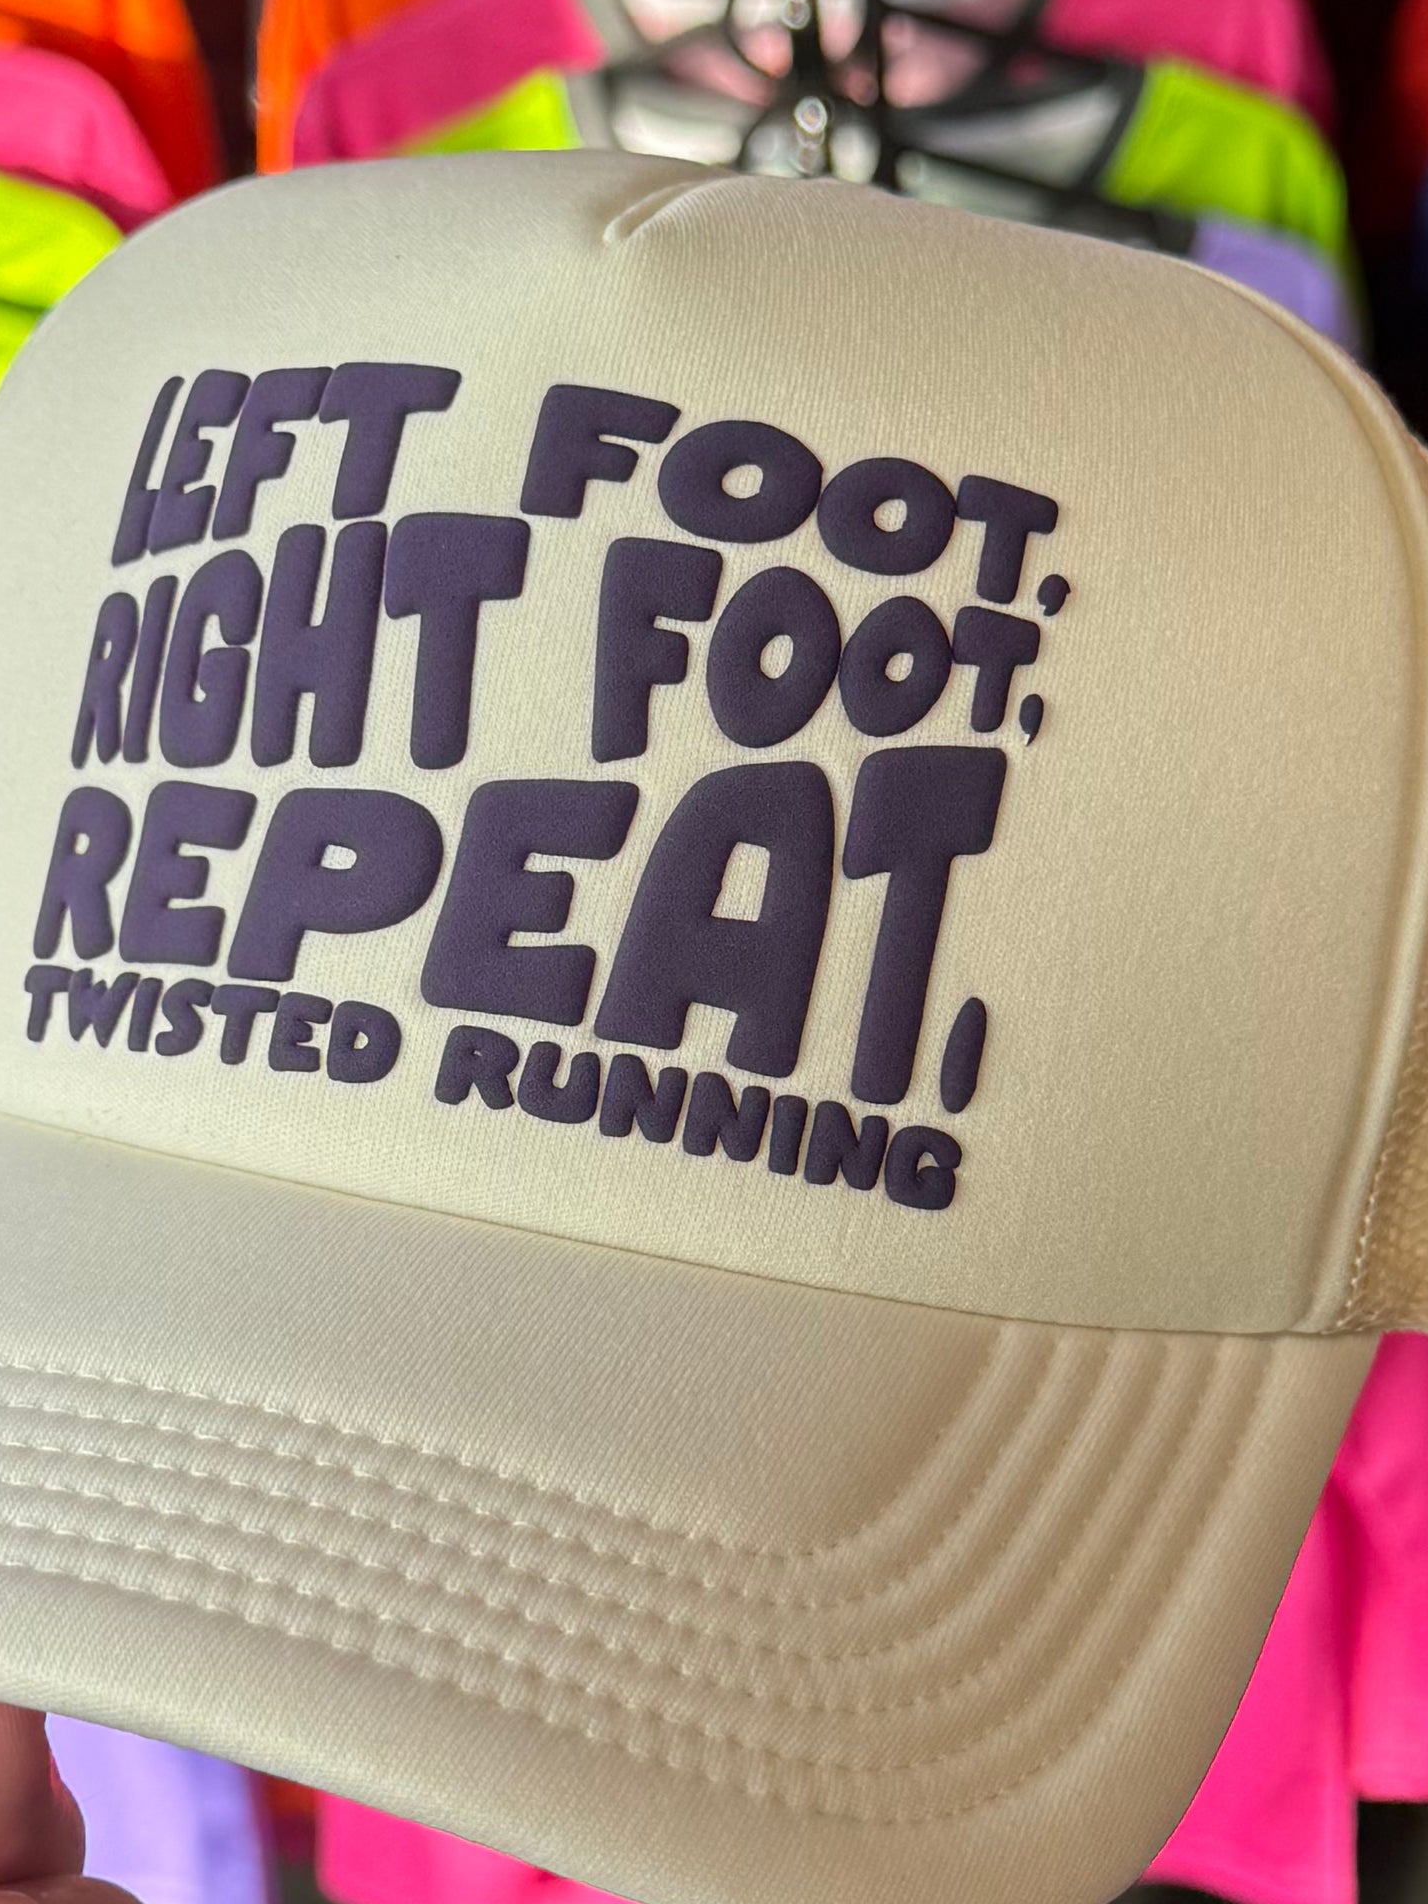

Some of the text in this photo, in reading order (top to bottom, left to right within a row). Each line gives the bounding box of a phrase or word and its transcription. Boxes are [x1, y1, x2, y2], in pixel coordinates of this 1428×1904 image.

[111, 362, 1072, 617] LEFT FOOT,
[72, 512, 1044, 770] RIGHT FOOT,
[25, 965, 963, 1211] TWISTED RUNNING
